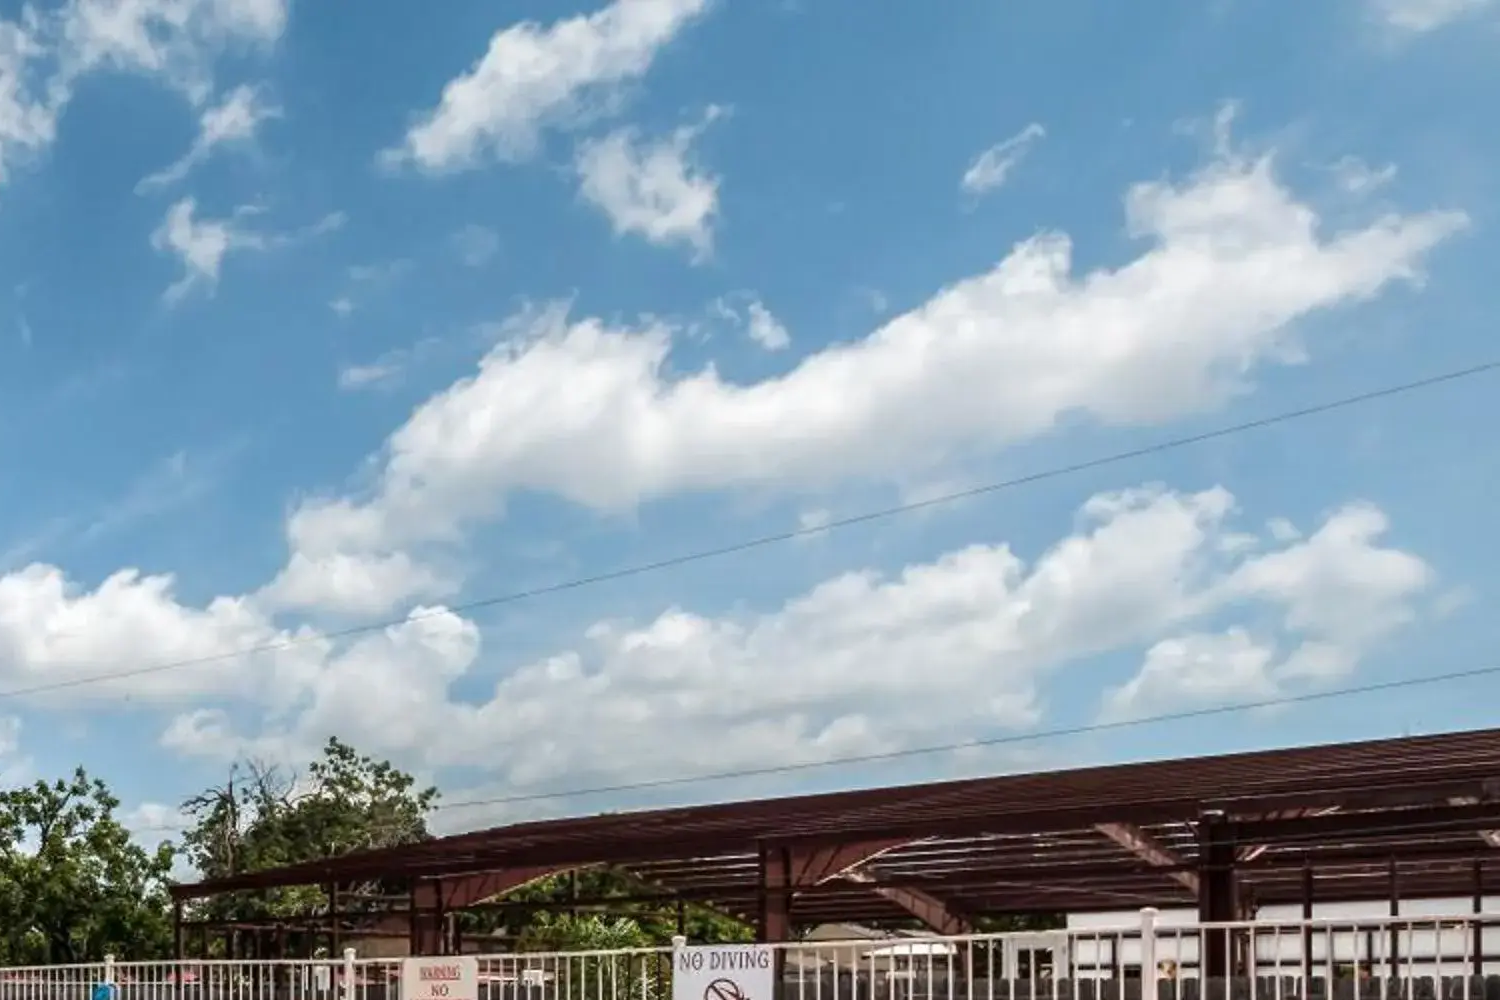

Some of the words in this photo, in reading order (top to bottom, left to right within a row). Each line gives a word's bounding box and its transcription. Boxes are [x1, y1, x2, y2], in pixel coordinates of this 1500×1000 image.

[680, 952, 704, 970] NO
[710, 950, 770, 969] DIVING
[431, 984, 449, 996] NO
